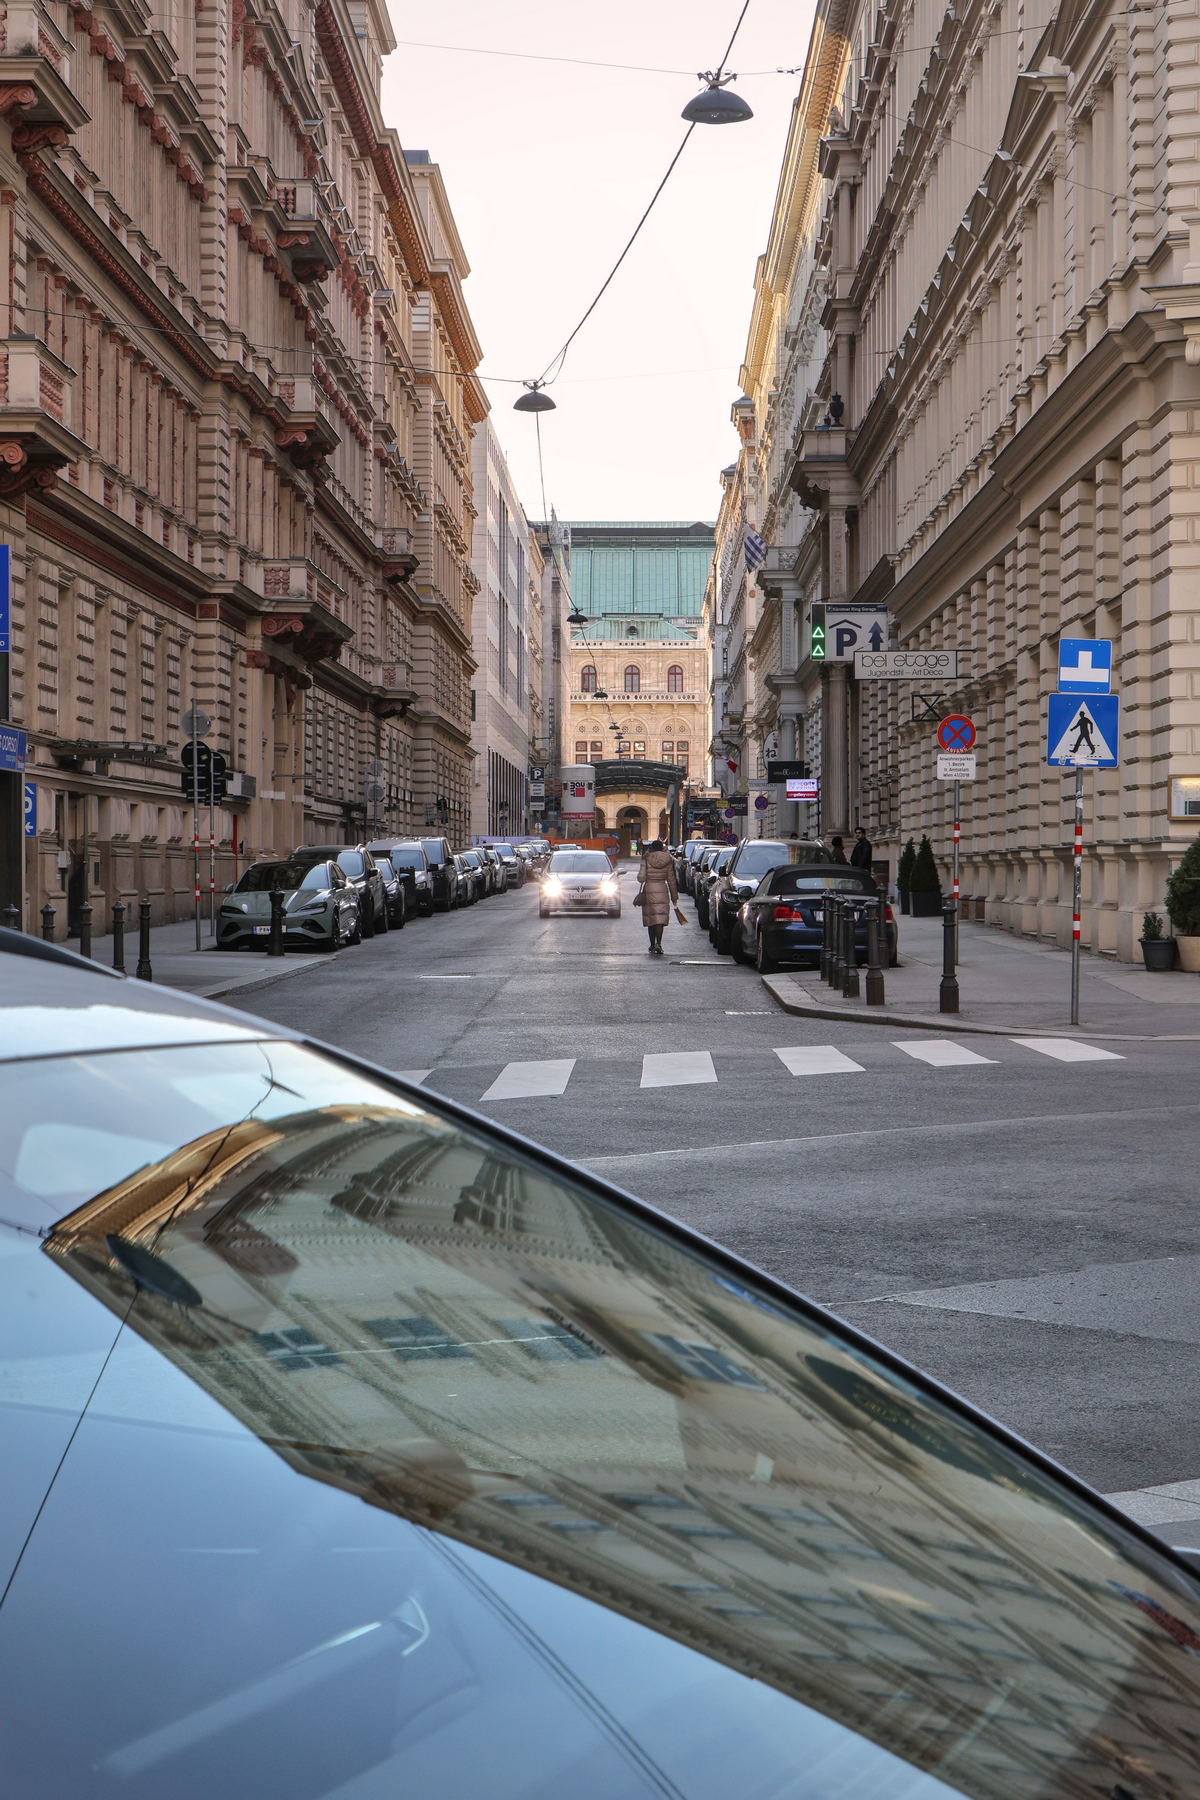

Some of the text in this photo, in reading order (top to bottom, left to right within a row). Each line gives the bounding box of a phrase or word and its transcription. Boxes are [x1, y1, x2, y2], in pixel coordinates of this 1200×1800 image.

[836, 628, 858, 657] P
[861, 653, 950, 669] bel etage
[868, 669, 904, 678] Jugendstil
[2, 735, 18, 753] CORSO
[945, 746, 968, 754] ANFANG
[534, 770, 542, 779] P
